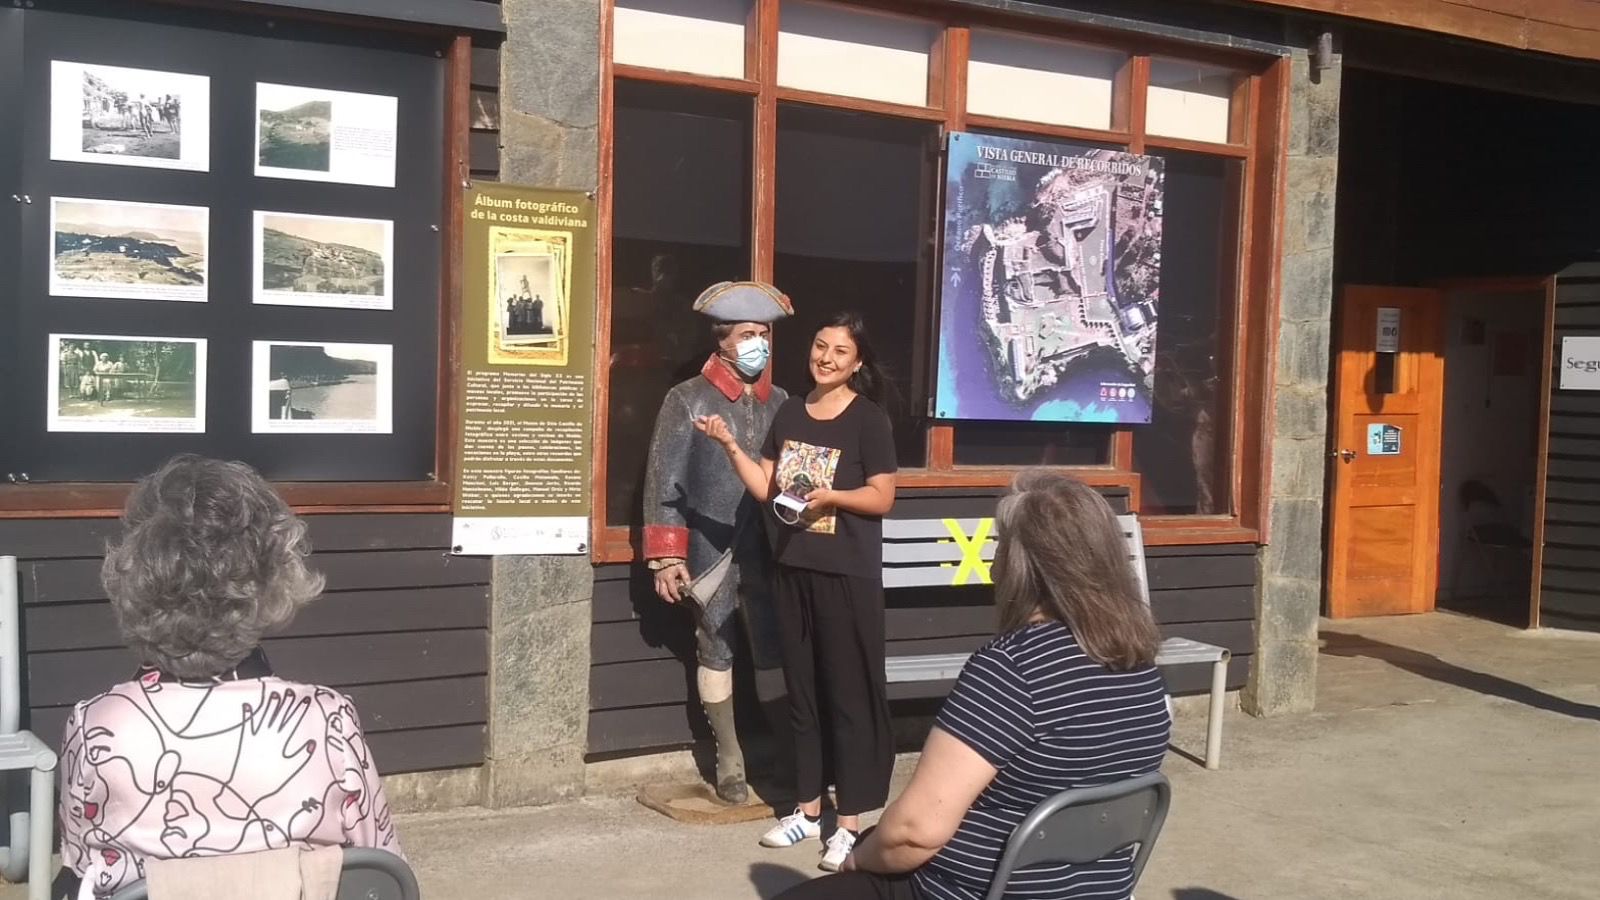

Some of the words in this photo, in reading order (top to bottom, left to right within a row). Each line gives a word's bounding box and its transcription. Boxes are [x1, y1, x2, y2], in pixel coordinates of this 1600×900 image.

[976, 146, 1008, 161] VISTA
[1010, 150, 1060, 167] GENERAL
[1061, 156, 1074, 168] DE
[1077, 158, 1142, 176] RECORRIDOS
[474, 193, 512, 209] Álbum
[515, 199, 579, 214] fotográfico
[471, 209, 484, 219] de
[487, 211, 497, 220] la
[500, 214, 529, 224] costa
[531, 214, 588, 228] valdiviana
